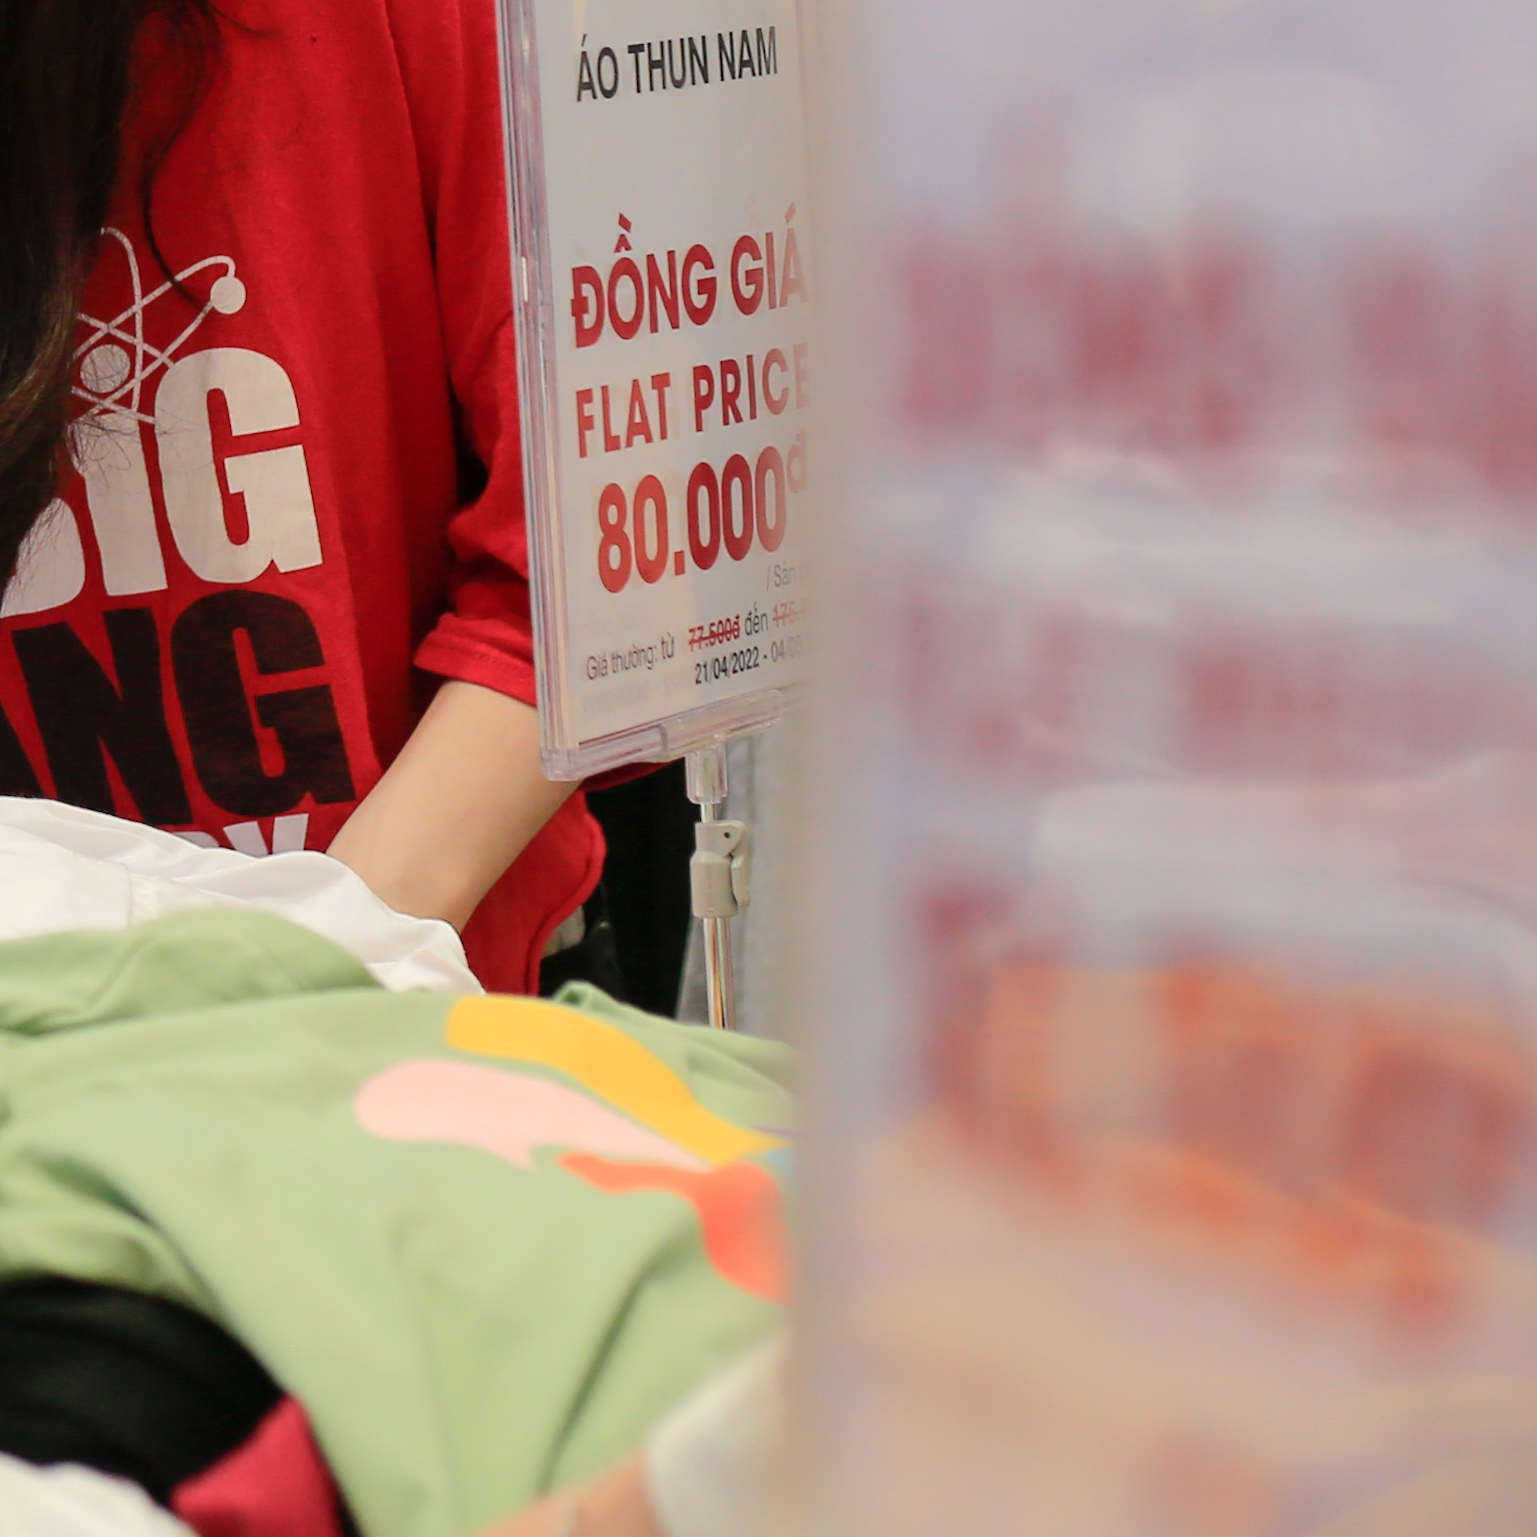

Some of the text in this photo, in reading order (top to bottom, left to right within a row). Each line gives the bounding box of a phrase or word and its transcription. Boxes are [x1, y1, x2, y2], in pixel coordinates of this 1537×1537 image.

[577, 26, 778, 102] ÁO THUN NAM
[570, 201, 808, 349] ĐỒNG GIÁ
[576, 343, 812, 459] FLAT PRICE
[586, 651, 608, 681] Giá
[611, 644, 658, 674] thường:
[661, 631, 675, 660] từ
[744, 602, 769, 637] đến
[694, 646, 760, 685] 21/04/2022
